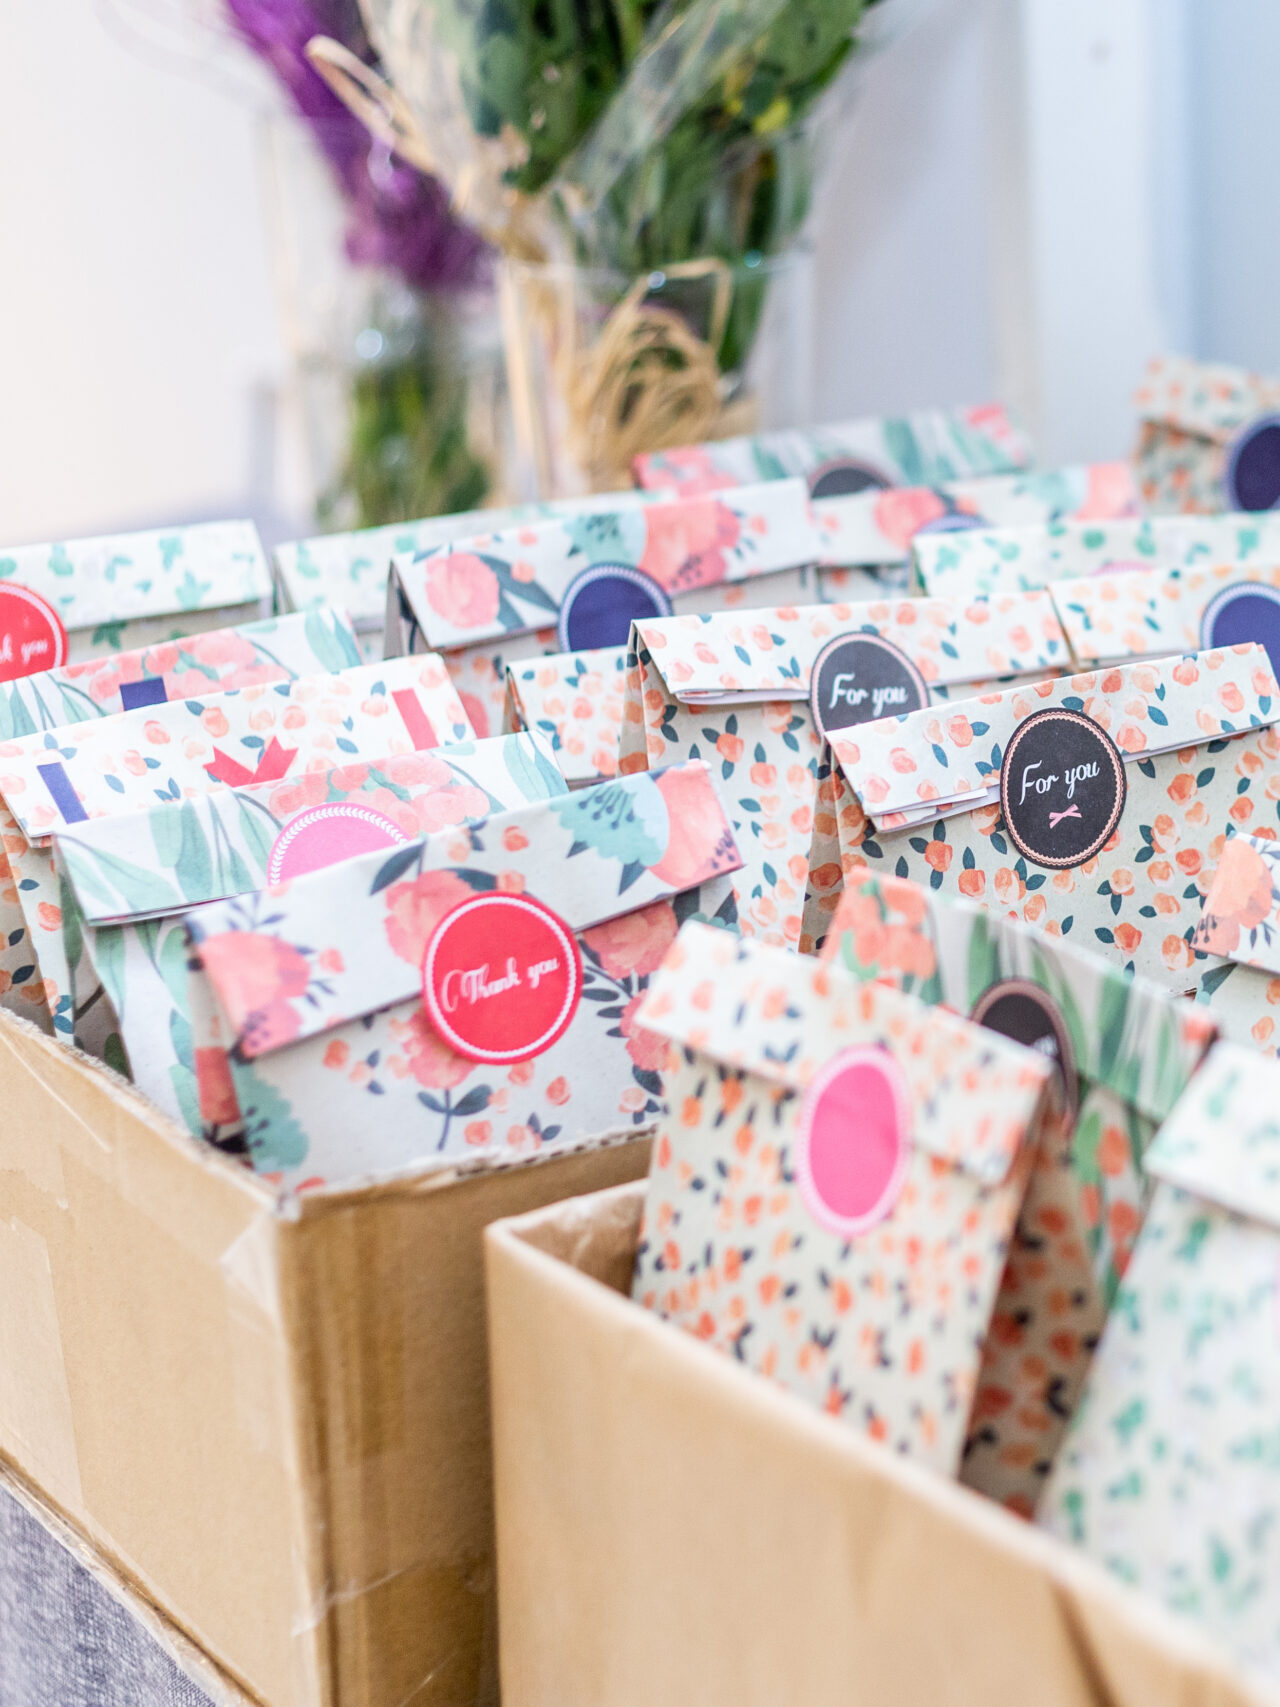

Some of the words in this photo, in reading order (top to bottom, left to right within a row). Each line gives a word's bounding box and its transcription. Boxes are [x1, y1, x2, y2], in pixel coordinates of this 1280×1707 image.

[21, 639, 49, 666] you
[828, 672, 869, 710] For
[872, 686, 908, 718] you
[1019, 759, 1060, 806] For
[1064, 761, 1101, 800] you
[441, 956, 523, 1013] Thank
[527, 957, 561, 989] you
